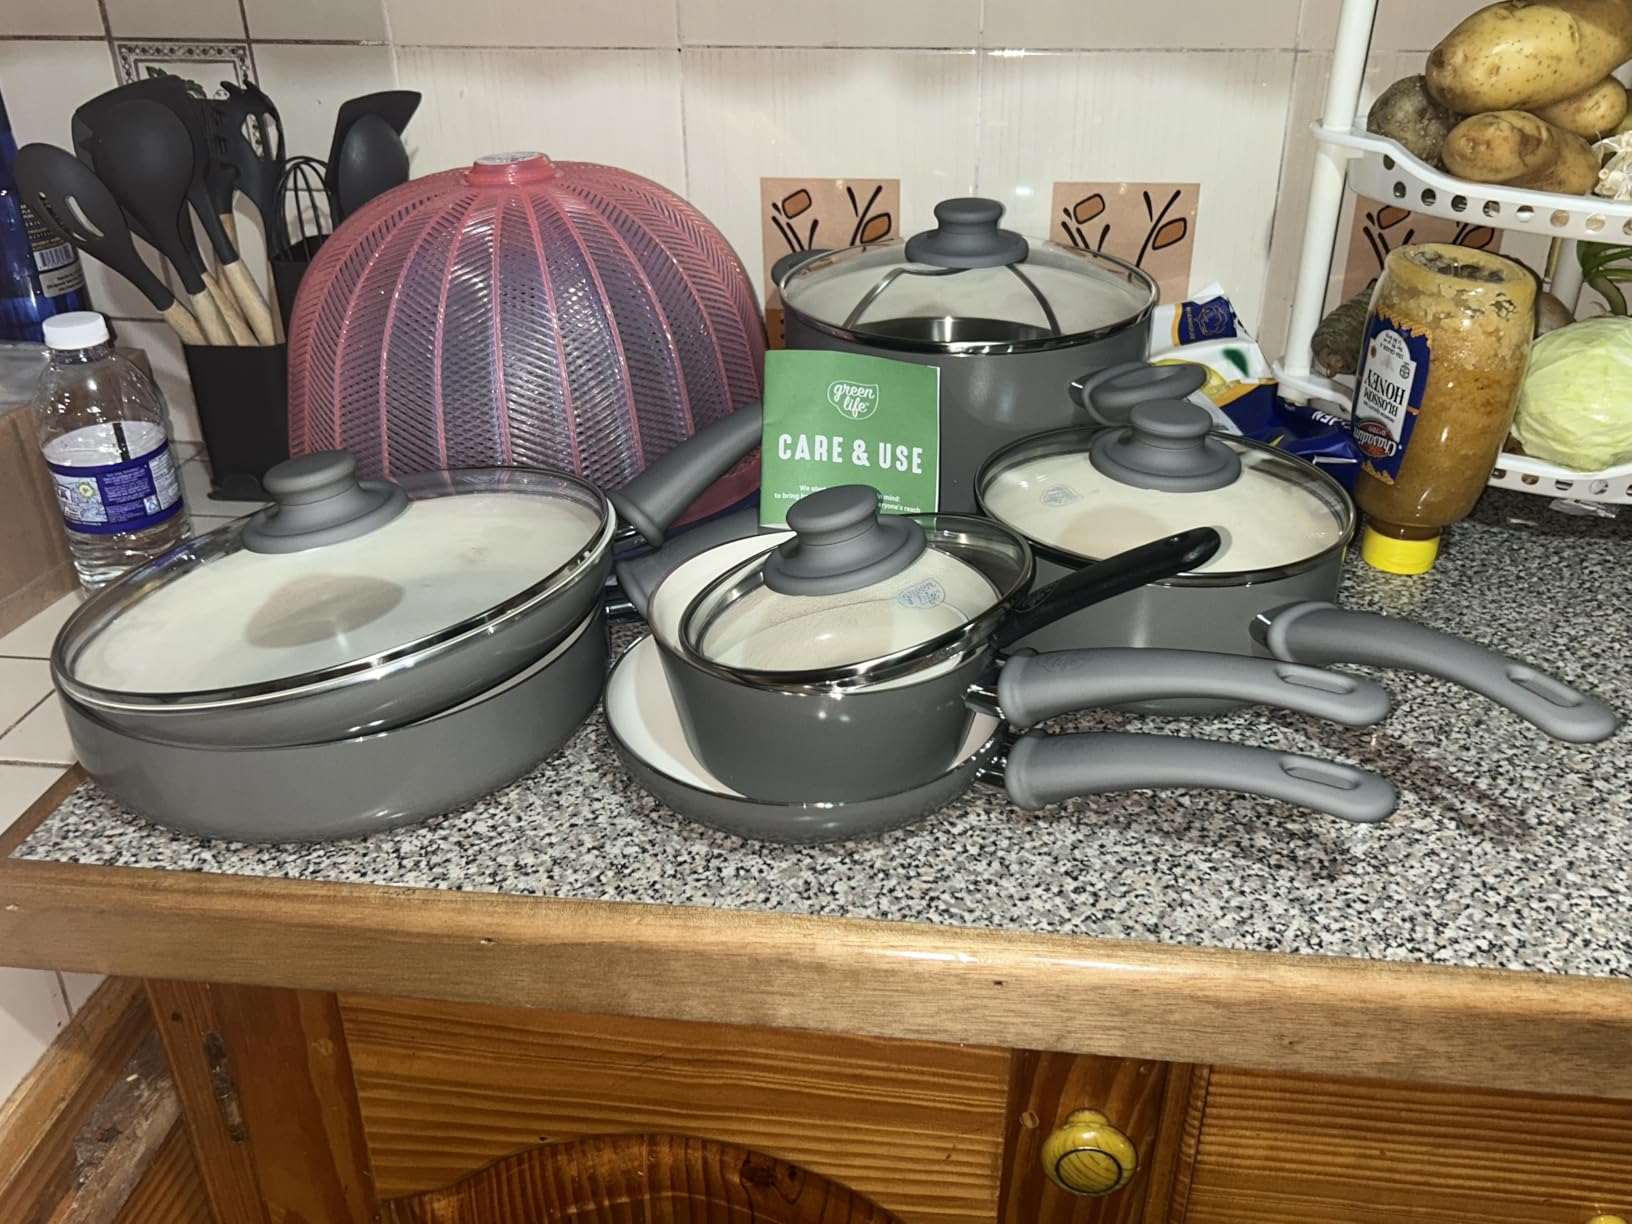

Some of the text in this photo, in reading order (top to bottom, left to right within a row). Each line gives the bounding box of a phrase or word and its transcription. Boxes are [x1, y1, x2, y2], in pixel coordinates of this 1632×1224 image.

[833, 383, 875, 402] green
[1364, 369, 1406, 406] HONEY
[843, 397, 867, 418] life
[1363, 387, 1399, 418] BLOSSOM
[1353, 426, 1397, 457] Chasadim
[778, 433, 923, 474] CARE & USE
[782, 490, 801, 501] bring
[800, 484, 810, 492] We
[877, 502, 921, 513] eryone's reach
